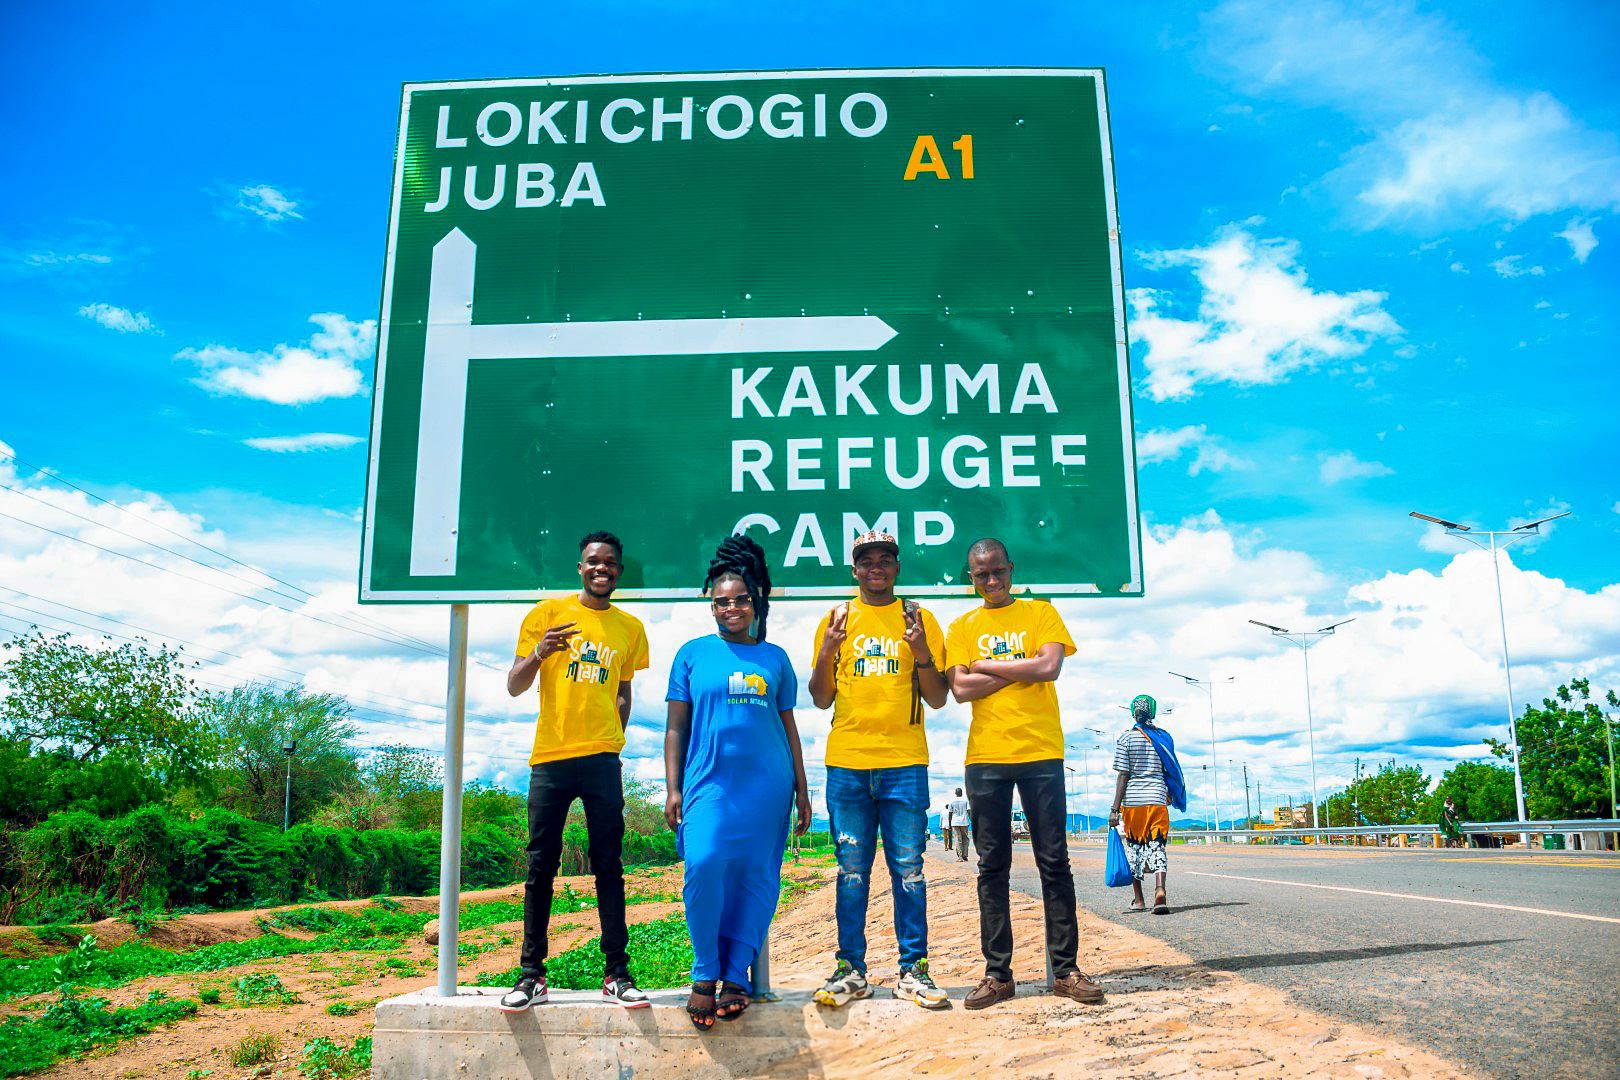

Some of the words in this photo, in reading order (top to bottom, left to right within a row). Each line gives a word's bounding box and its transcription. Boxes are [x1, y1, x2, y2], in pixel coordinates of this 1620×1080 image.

[434, 93, 888, 148] LOKICHOGIO
[904, 135, 975, 181] A1
[424, 163, 606, 213] JUBA
[732, 363, 1059, 418] KAKUMA
[731, 435, 1088, 492] REFUGEE
